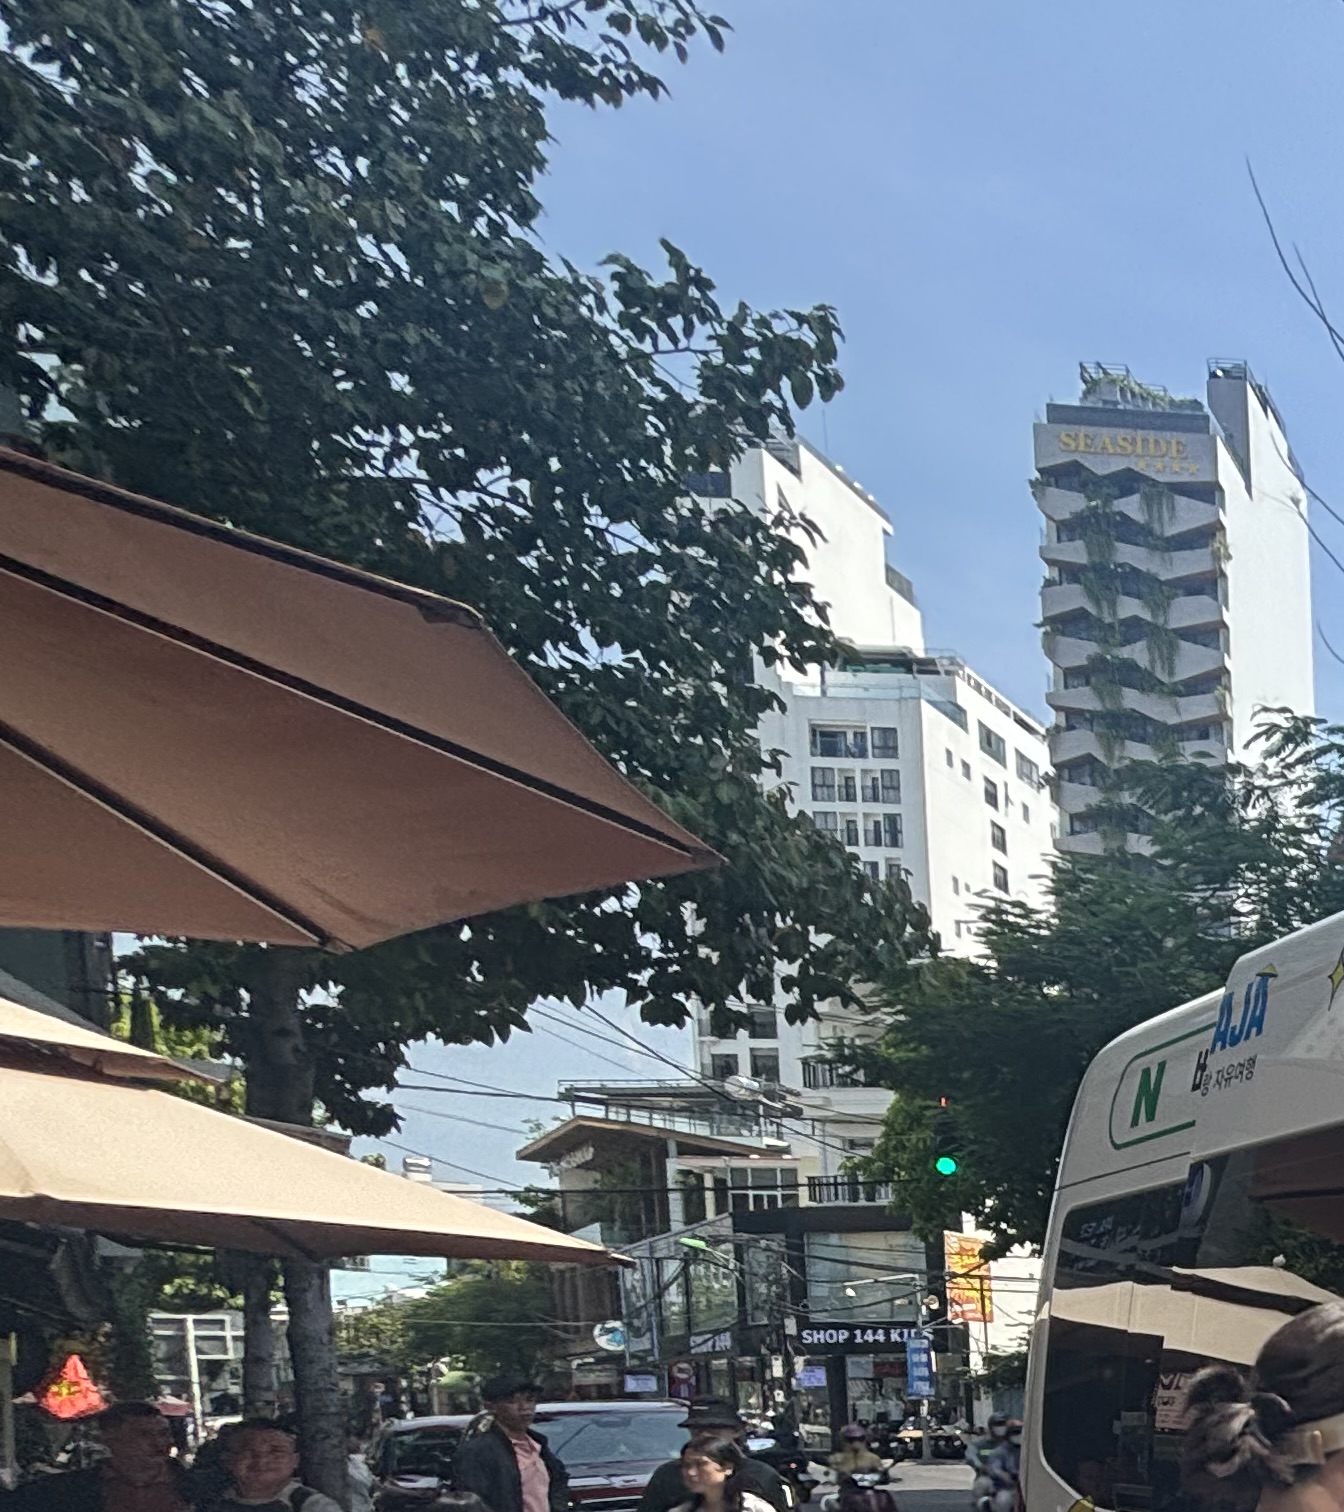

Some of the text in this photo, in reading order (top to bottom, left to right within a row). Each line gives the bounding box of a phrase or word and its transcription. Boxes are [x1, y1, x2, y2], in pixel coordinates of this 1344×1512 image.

[1059, 431, 1188, 459] SEASIDE
[1213, 1053, 1258, 1091] 자유여행
[1130, 1060, 1167, 1128] N
[801, 1329, 849, 1344] SHOP
[853, 1328, 886, 1344] 144
